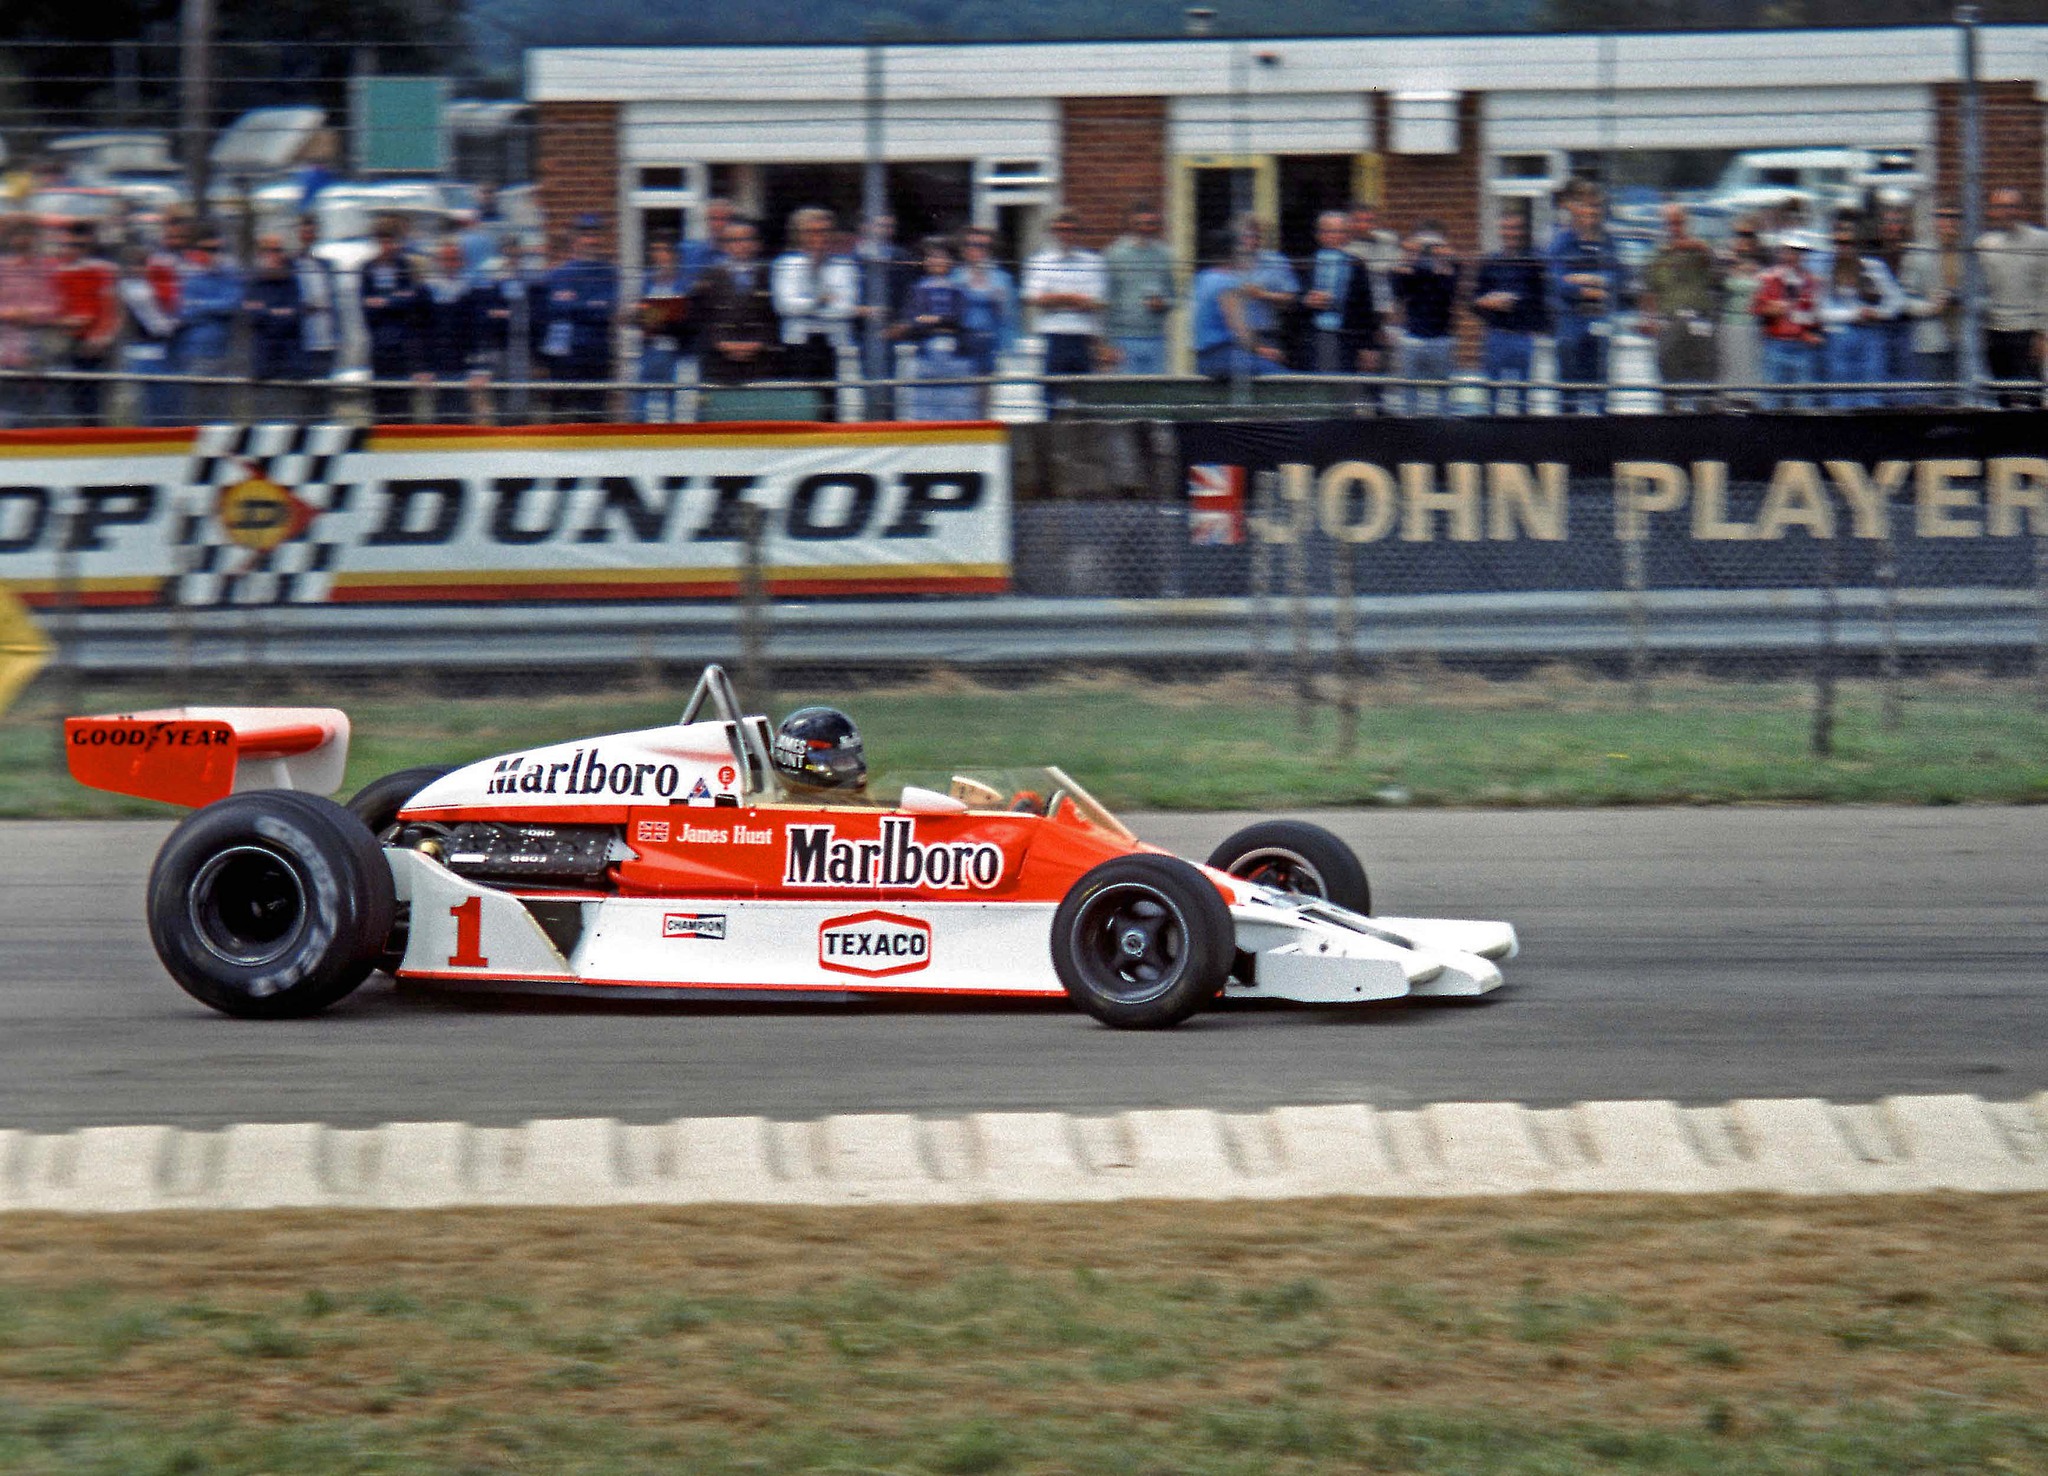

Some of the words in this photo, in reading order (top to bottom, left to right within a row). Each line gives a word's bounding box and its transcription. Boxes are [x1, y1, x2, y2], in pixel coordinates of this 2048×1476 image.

[362, 471, 985, 547] DUNLOP
[1611, 457, 2048, 542] PLAYER
[487, 748, 680, 798] Marlboro
[676, 823, 728, 843] James
[733, 825, 773, 845] Hunt
[785, 818, 1001, 886] Marlboro
[448, 896, 489, 968] 1
[667, 919, 723, 932] CHAMPION
[824, 933, 926, 957] TEXACO
